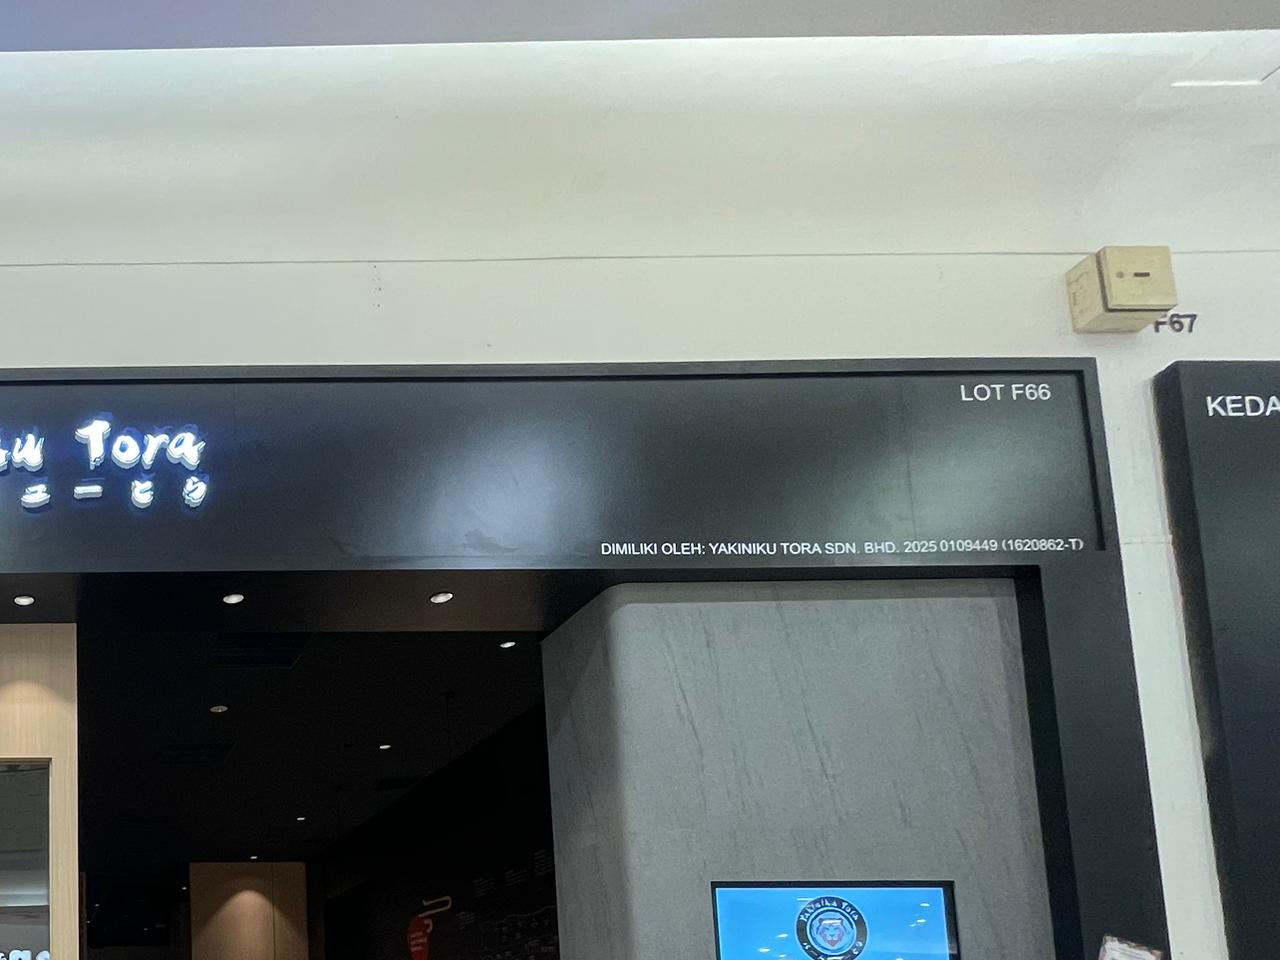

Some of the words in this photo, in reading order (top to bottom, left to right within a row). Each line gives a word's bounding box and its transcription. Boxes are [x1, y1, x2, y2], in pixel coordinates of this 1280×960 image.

[960, 384, 1004, 401] LOT
[1011, 384, 1052, 401] F66
[74, 419, 207, 470] Tora
[601, 542, 658, 556] DIMILIKI
[661, 542, 706, 555] OLEH:
[709, 542, 777, 555] YAKINIKU
[781, 542, 822, 555] TORA
[824, 542, 860, 555] SDN.
[864, 541, 900, 554] BHD.
[1001, 537, 1085, 552] (1620862-T)
